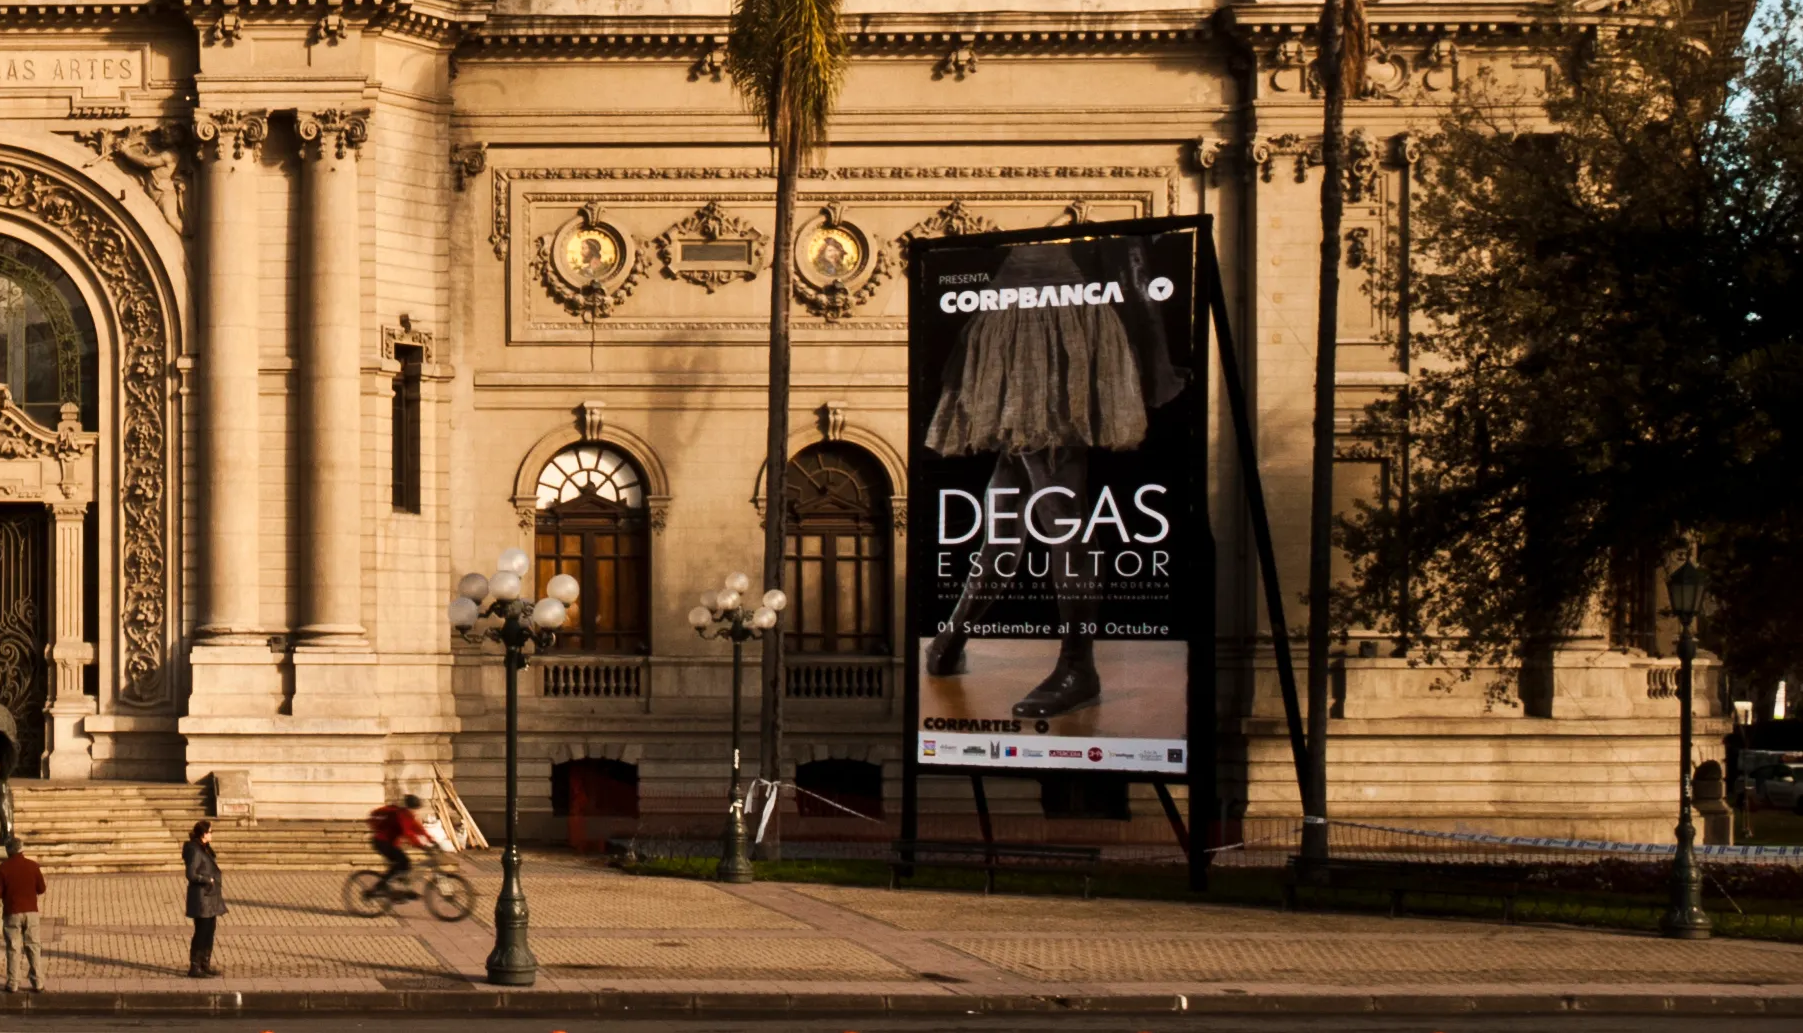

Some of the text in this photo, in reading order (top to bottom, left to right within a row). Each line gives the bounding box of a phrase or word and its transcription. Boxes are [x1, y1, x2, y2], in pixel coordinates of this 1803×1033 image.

[53, 58, 132, 81] ARTES
[939, 273, 990, 286] PRESENTA
[940, 282, 1124, 313] CORPBANCA
[939, 484, 1170, 545] DEGAS
[938, 550, 1170, 577] ESCULTOR
[1032, 581, 1047, 589] DE
[1055, 581, 1068, 589] LA
[1076, 581, 1103, 589] VIDA
[1111, 581, 1170, 589] MODERNA
[938, 621, 1169, 636] 01 Septiembre al 30 Octubre
[923, 717, 1022, 732] CORPARTES
